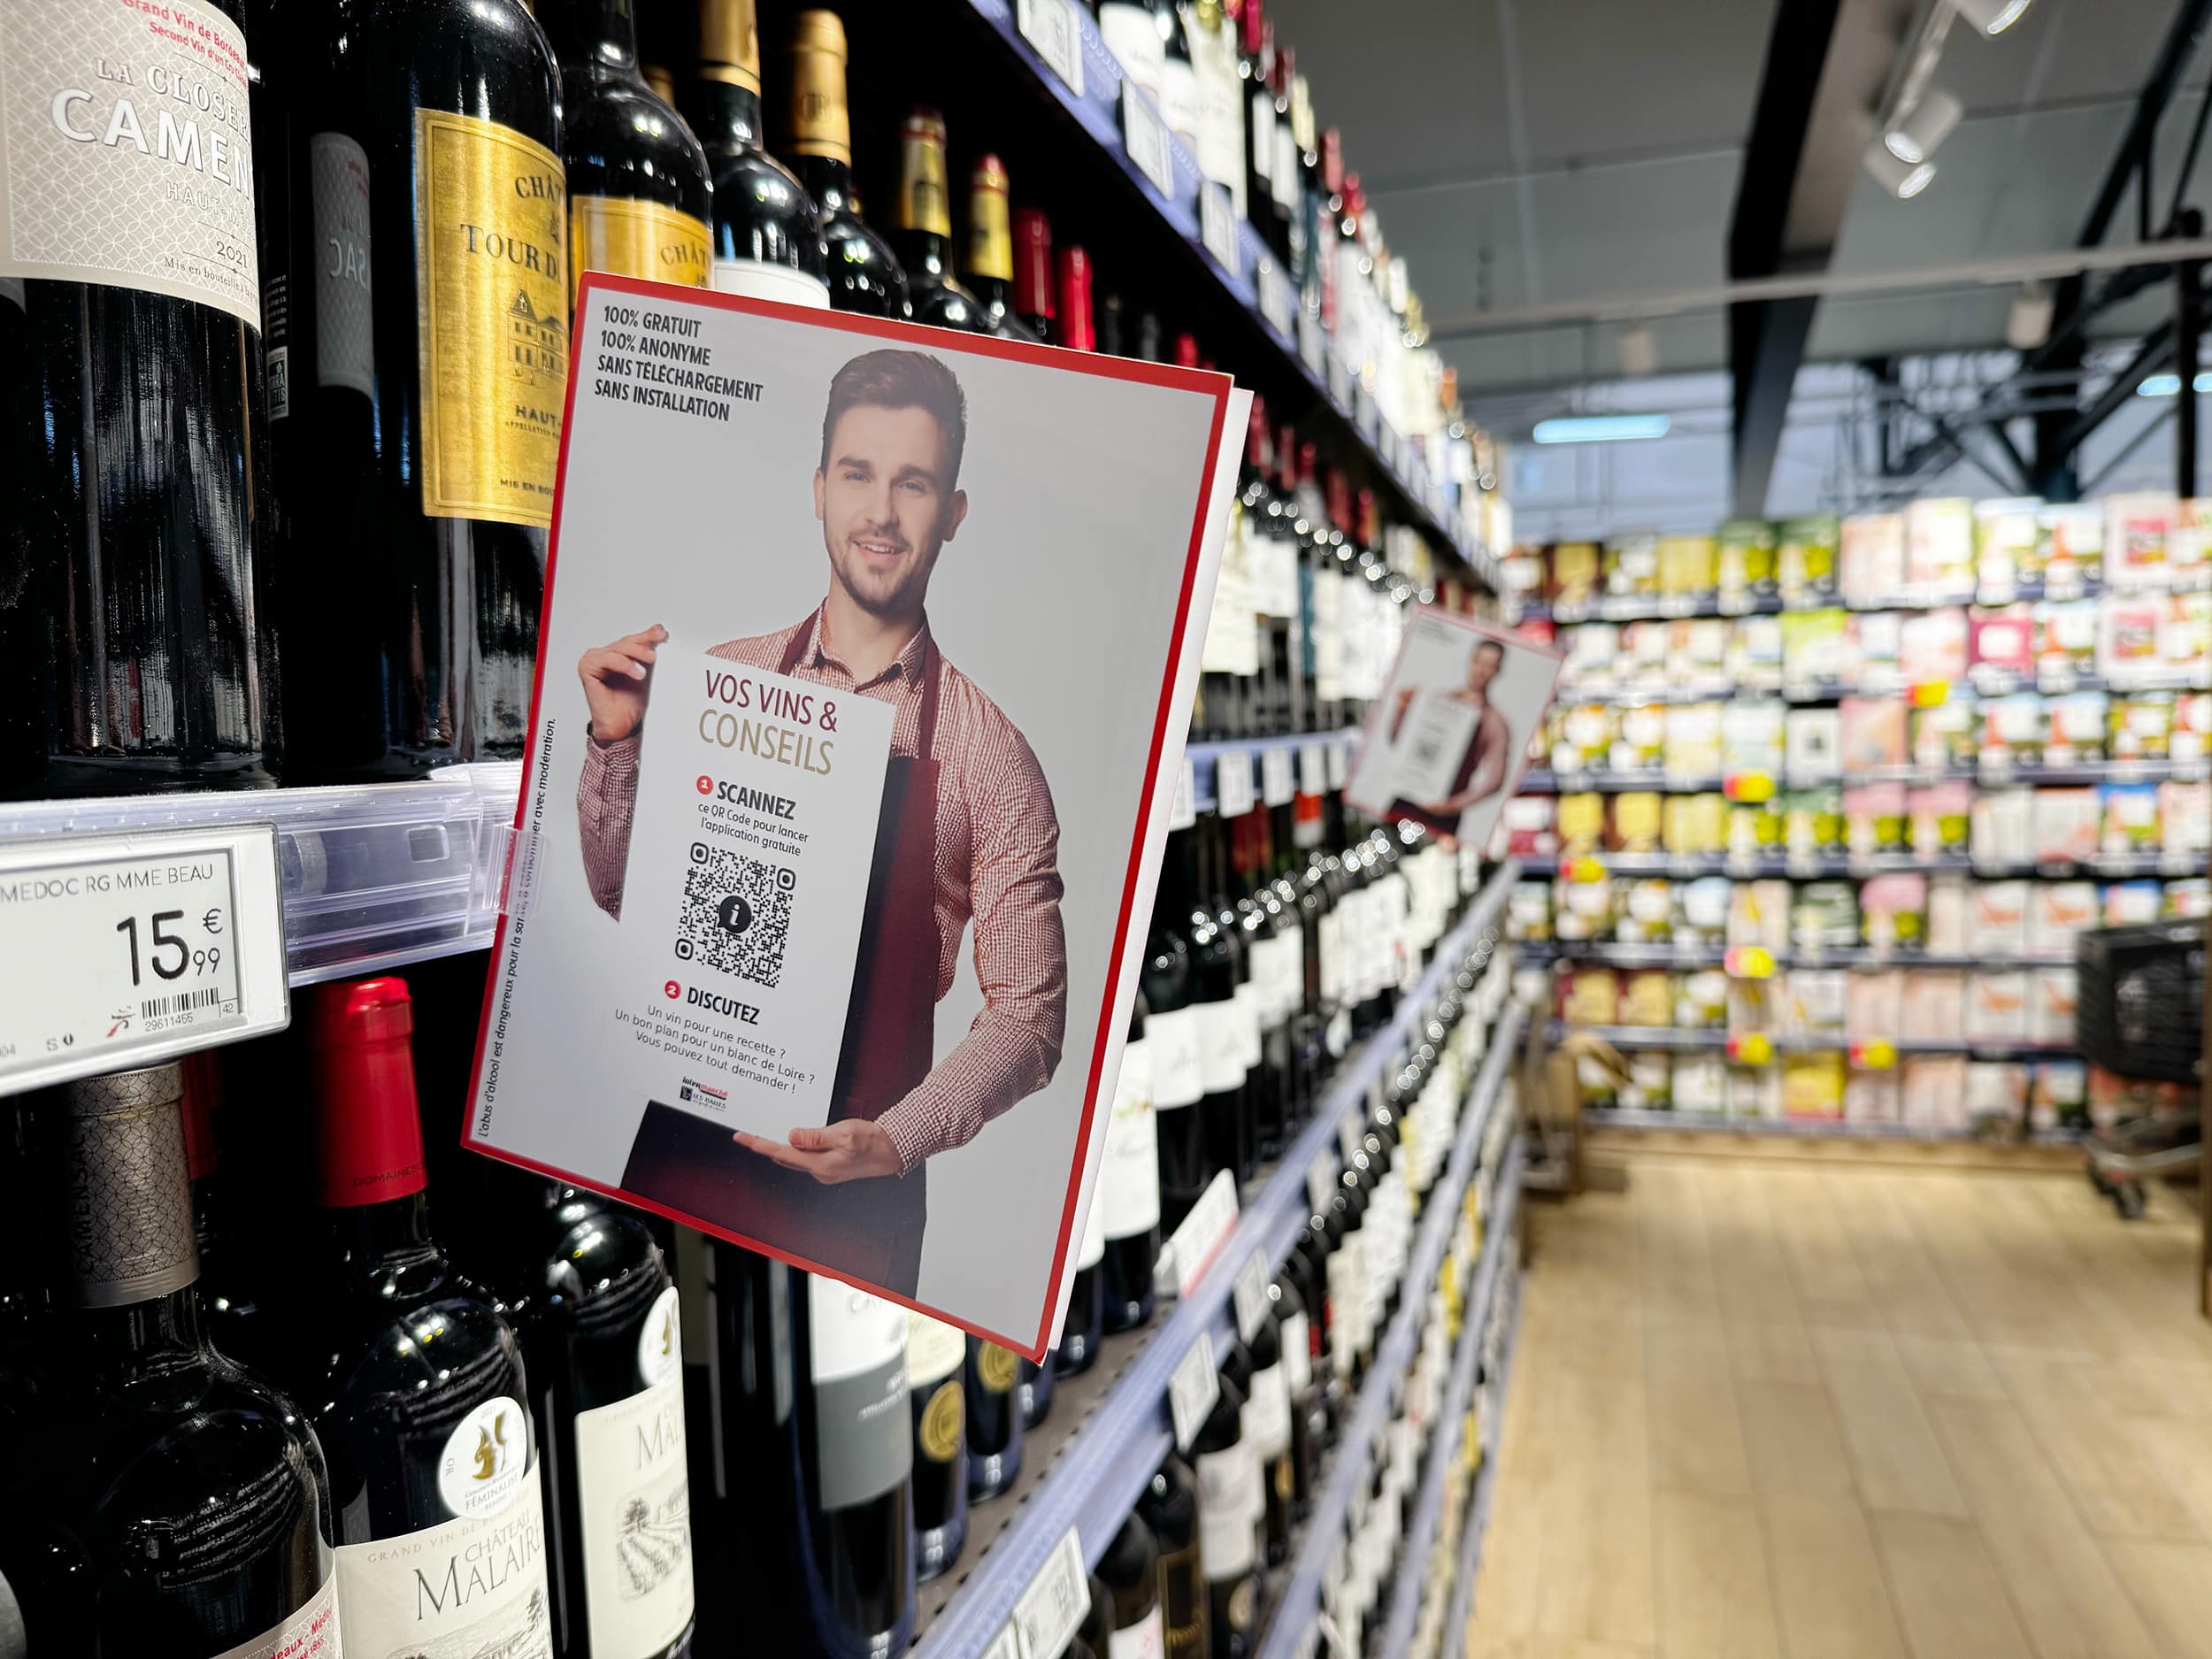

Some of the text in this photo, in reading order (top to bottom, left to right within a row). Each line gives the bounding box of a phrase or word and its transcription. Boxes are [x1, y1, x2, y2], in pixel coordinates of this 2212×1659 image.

[150, 21, 188, 46] Second
[190, 38, 205, 54] Vin
[173, 11, 195, 31] Vin
[198, 24, 211, 41] de
[96, 58, 134, 86] LA
[164, 256, 185, 271] Mis
[188, 264, 201, 275] en
[216, 241, 248, 269] 2021
[460, 224, 541, 273] TOUR
[603, 305, 702, 339] 100% GRATUIT
[601, 329, 711, 367] 100% ANONYME
[597, 355, 764, 403] SANS TÉLÉCHARGEMENT
[595, 379, 730, 422] SANS INSTALLATION
[522, 481, 535, 492] EN
[706, 669, 838, 733] VOS VINS &
[539, 718, 557, 790] modération.
[699, 708, 834, 776] CONSEILS
[534, 791, 545, 818] avec
[717, 780, 796, 821] SCANNEZ
[698, 803, 810, 843] ce QR Code pour lancer
[701, 816, 802, 856] l'application gratuite
[86, 874, 110, 894] RG
[117, 869, 162, 891] MME
[168, 863, 214, 884] BEAU
[116, 908, 223, 987] 15 €
[510, 936, 522, 949] la
[193, 948, 220, 976] 99
[508, 949, 520, 978] pour
[145, 1012, 194, 1033] 29611455
[222, 1002, 234, 1014] 42
[495, 978, 514, 1040] dangereux
[687, 986, 761, 1025] DISCUTEZ
[494, 1041, 503, 1057] est
[615, 1008, 816, 1085] Un bon plan pour un blanc de Loire ?
[647, 1004, 787, 1059] Un vin pour une recette ?
[635, 1030, 662, 1048] Vous
[664, 1041, 703, 1063] pouvez
[705, 1055, 729, 1071] tout
[731, 1064, 790, 1092] demander
[487, 1058, 501, 1102] d'alcool
[478, 1105, 493, 1138] L'abus
[367, 1542, 422, 1563] GRAND
[430, 1532, 454, 1547] VIN
